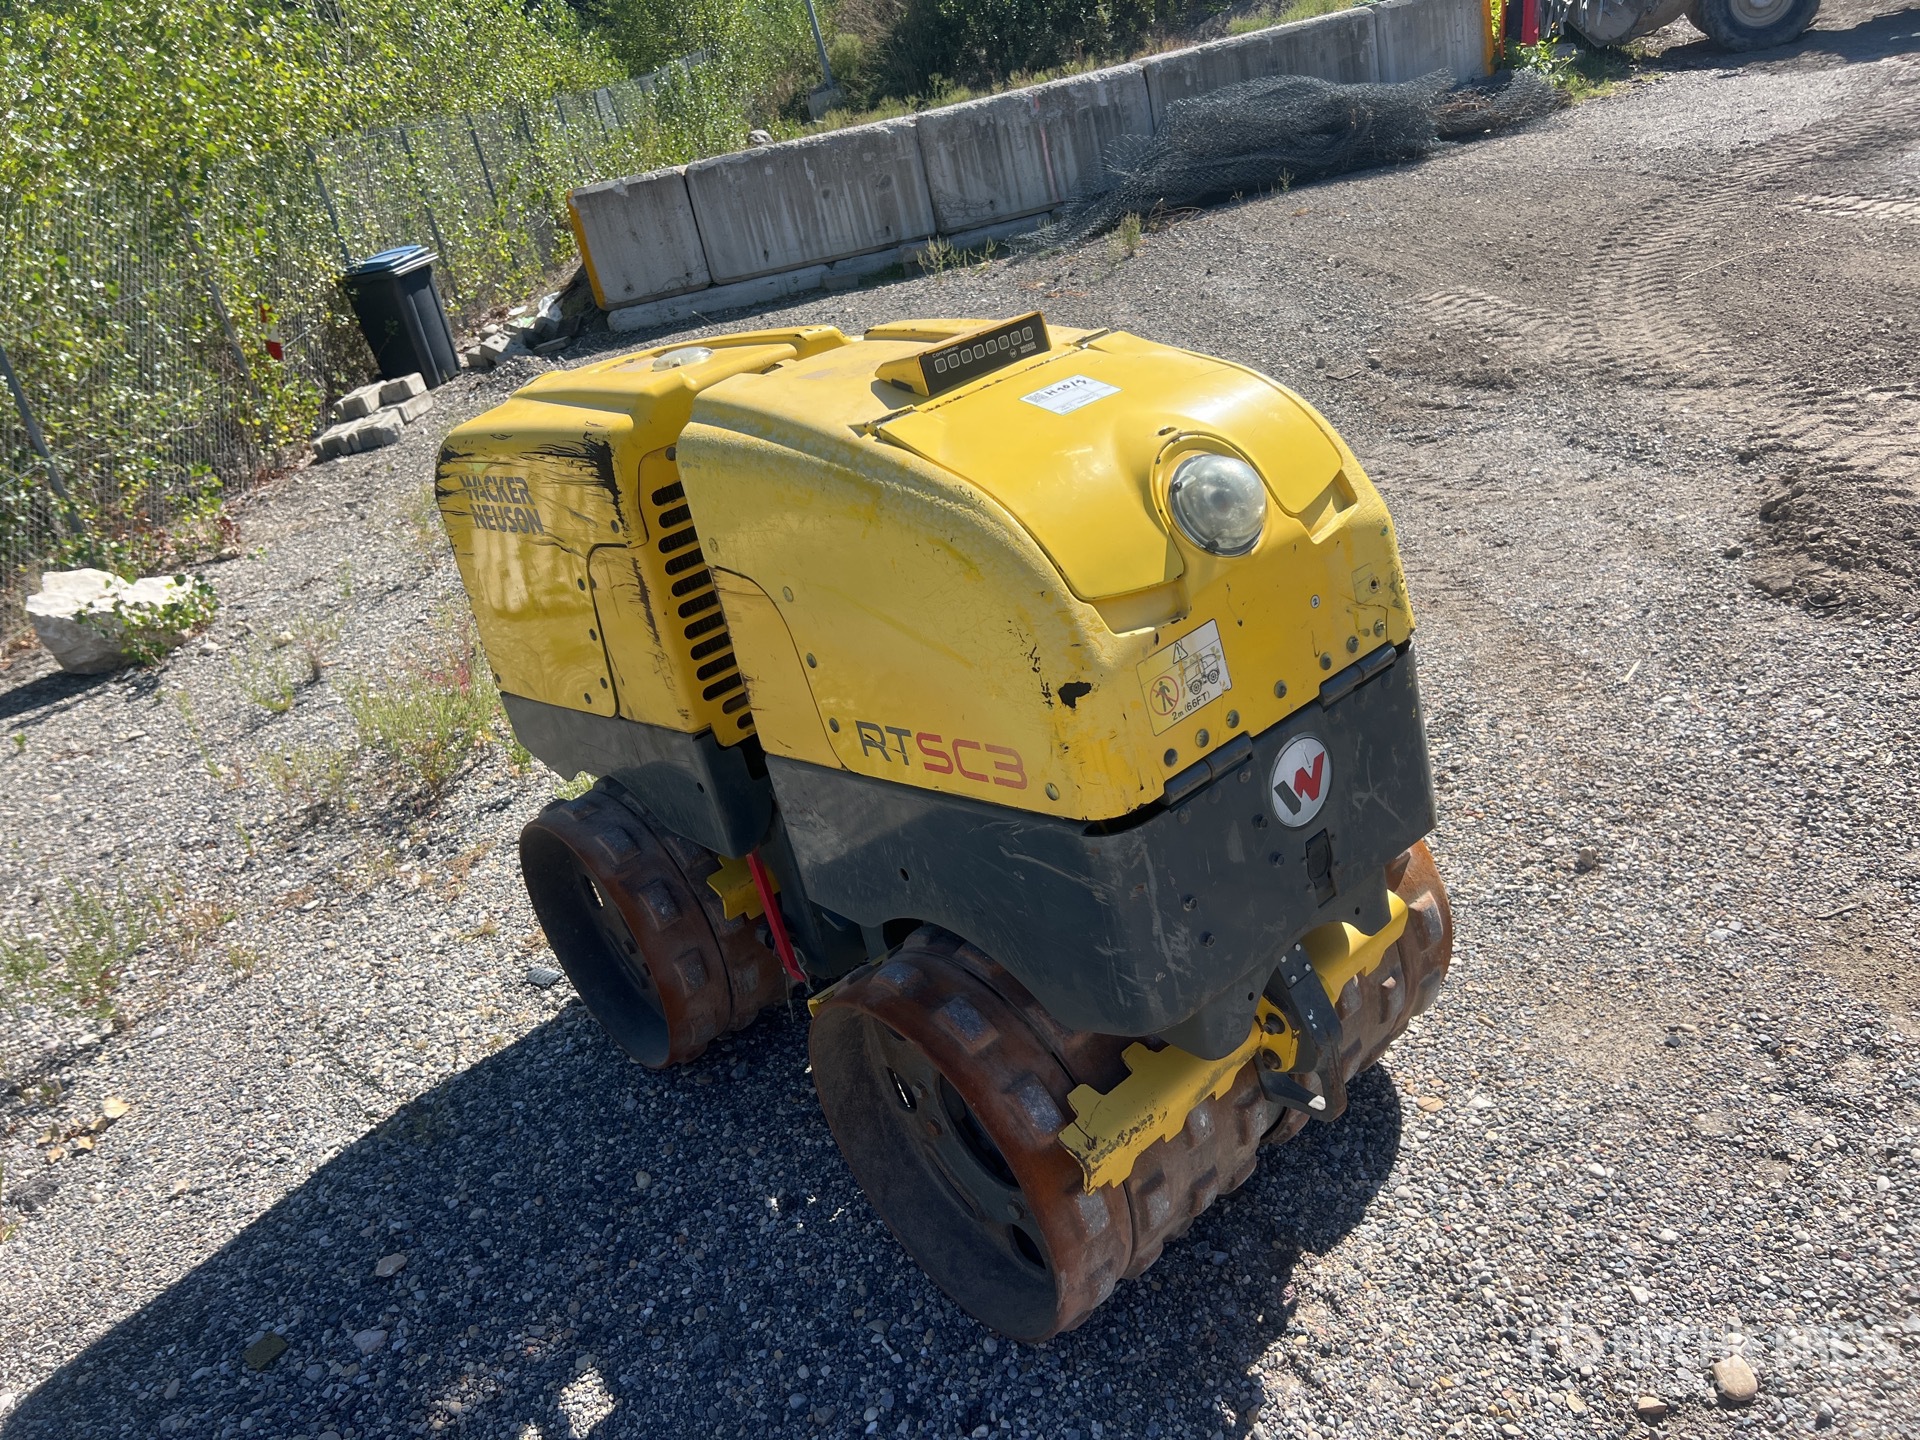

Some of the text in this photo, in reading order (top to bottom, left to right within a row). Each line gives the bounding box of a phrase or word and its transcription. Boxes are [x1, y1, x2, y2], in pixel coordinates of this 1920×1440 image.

[459, 475, 535, 505] WACKER
[469, 503, 545, 535] NEUSON
[1171, 710, 1185, 722] 2m
